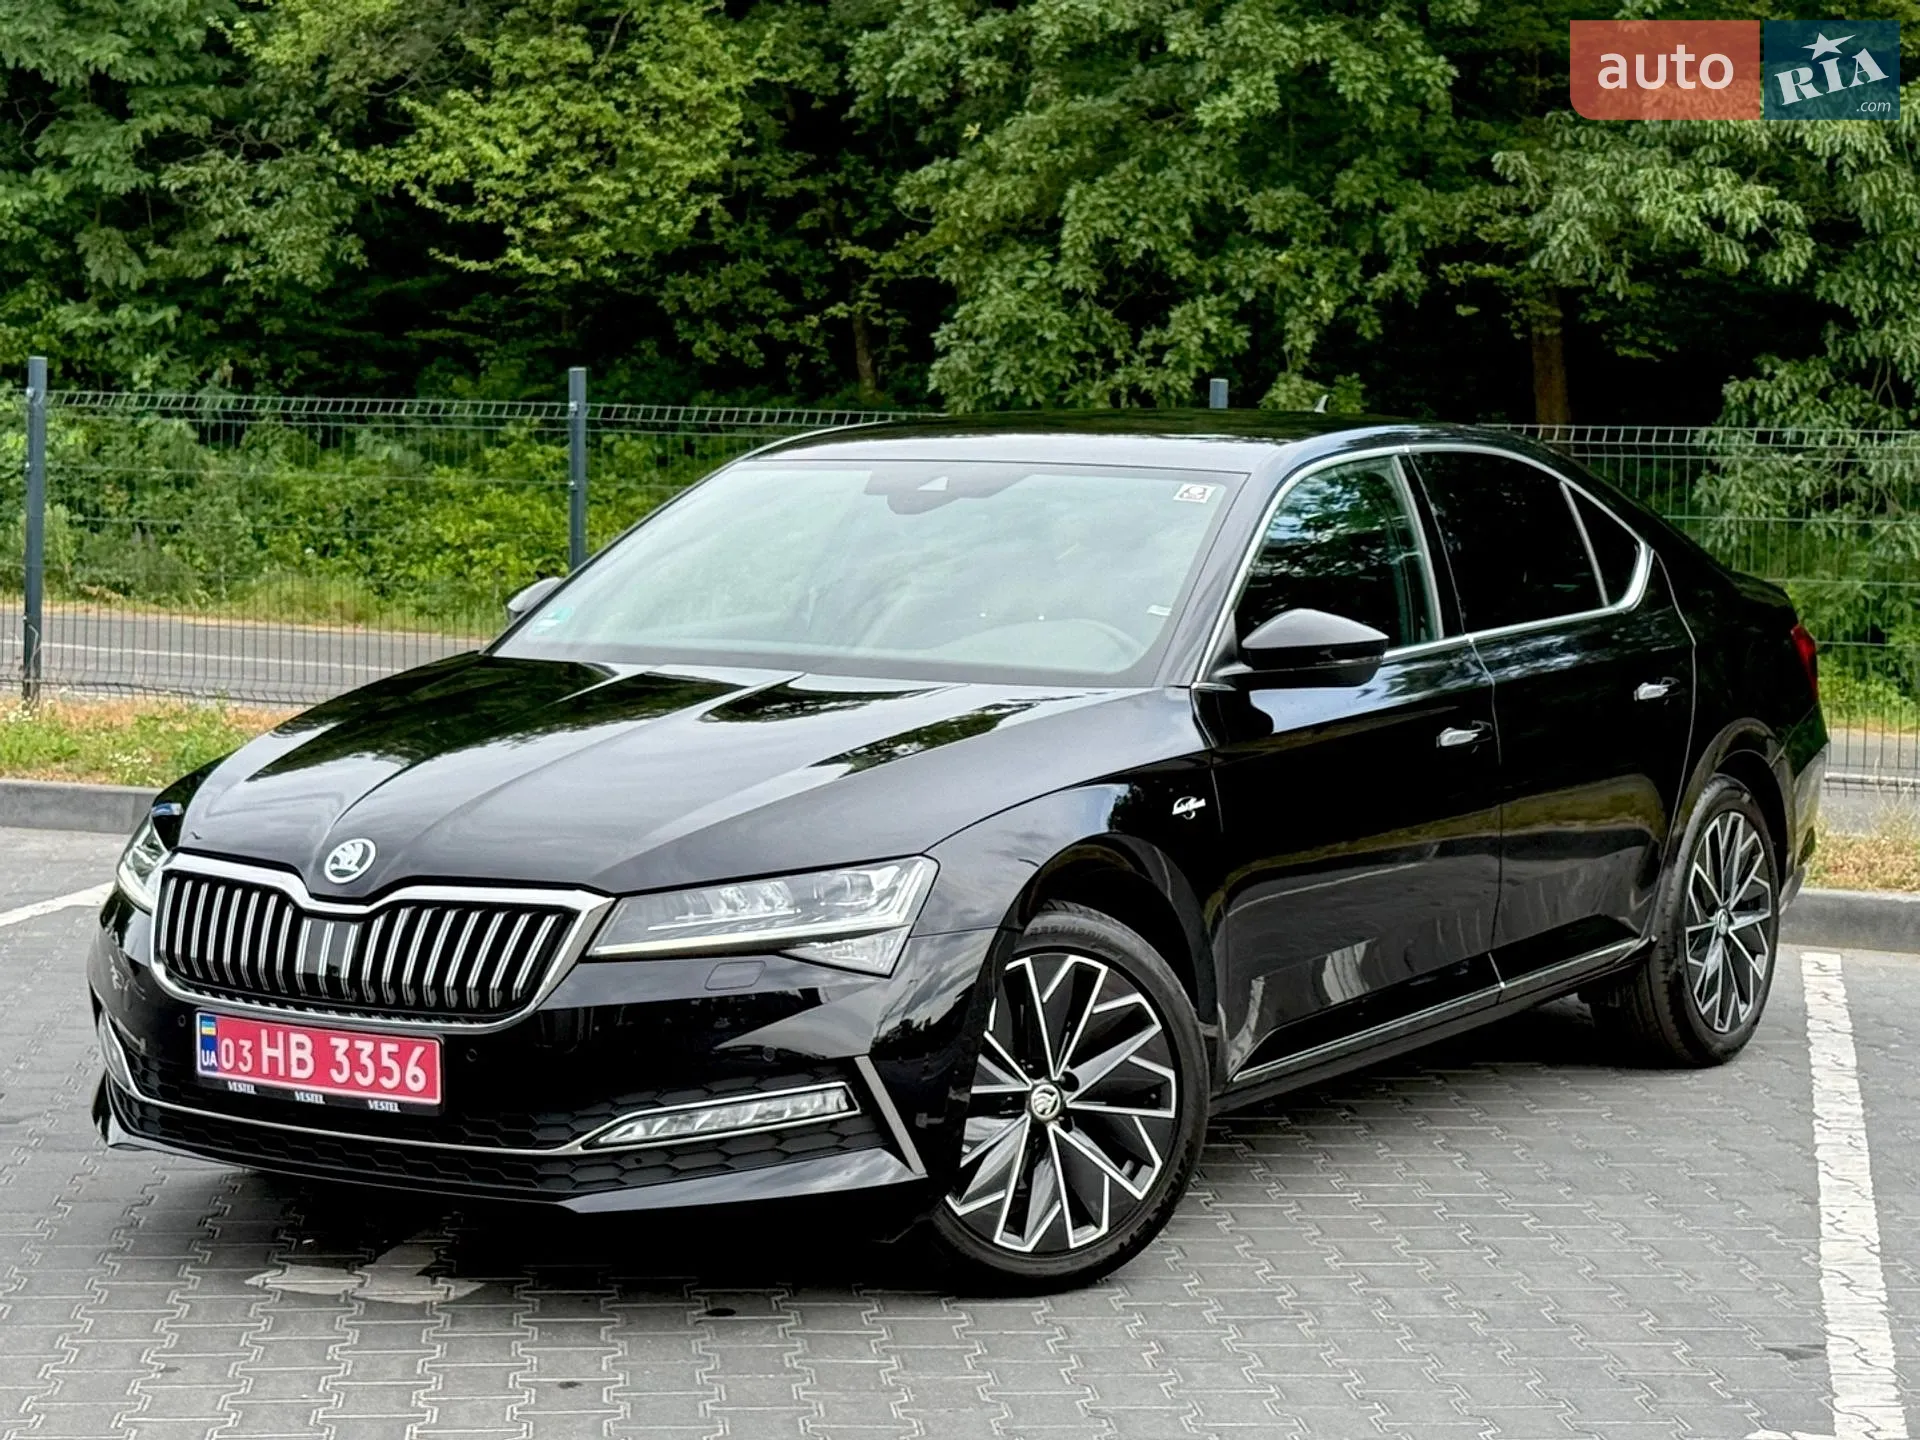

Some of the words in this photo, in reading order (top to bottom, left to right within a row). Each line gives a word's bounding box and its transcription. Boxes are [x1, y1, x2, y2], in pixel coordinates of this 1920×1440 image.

[201, 1049, 218, 1067] UA
[220, 1037, 253, 1073] 03
[260, 1029, 315, 1079] HB
[329, 1037, 427, 1093] 3356
[227, 1080, 257, 1094] VESTEL
[294, 1091, 326, 1105] VESTEL
[368, 1099, 401, 1113] VESTEL
